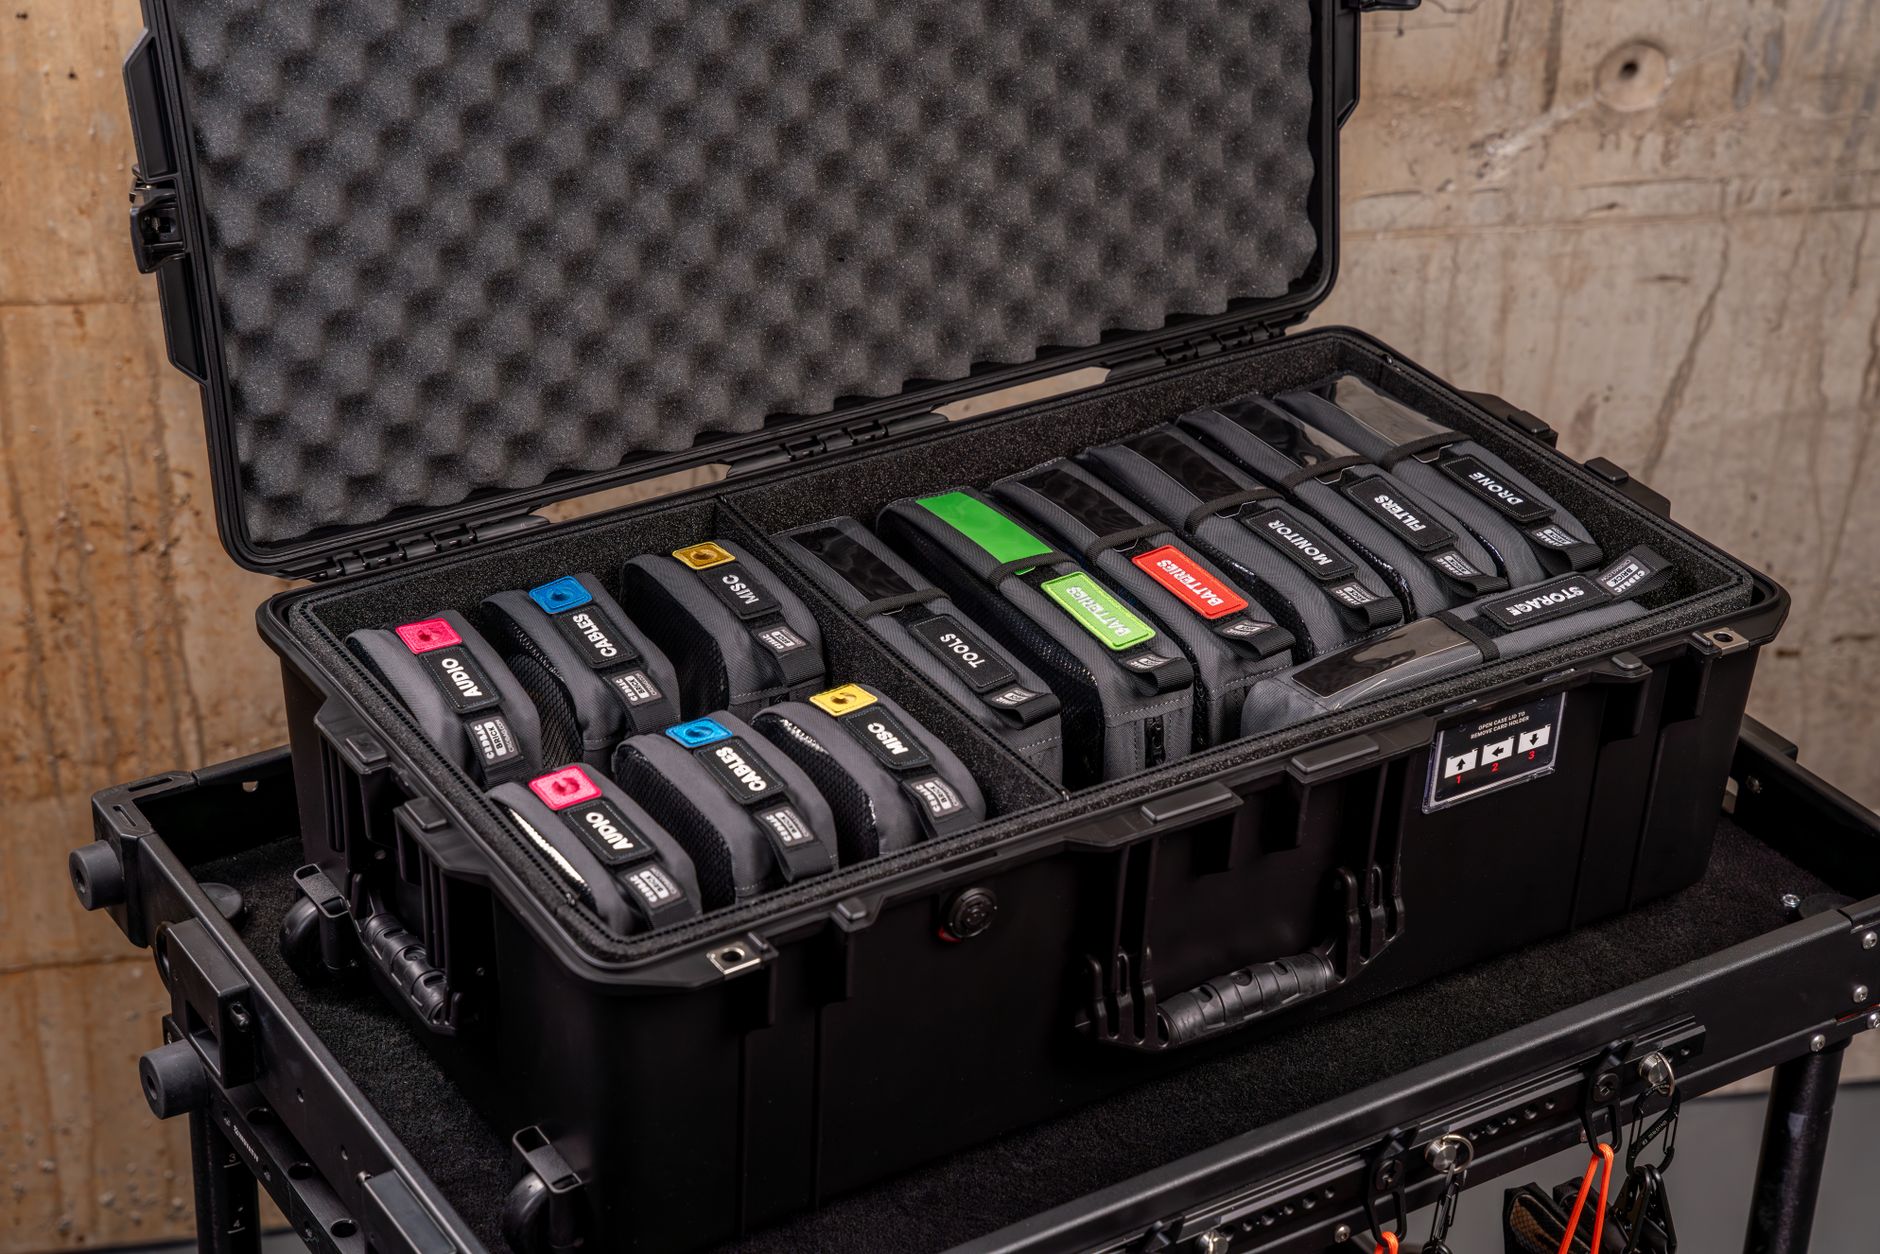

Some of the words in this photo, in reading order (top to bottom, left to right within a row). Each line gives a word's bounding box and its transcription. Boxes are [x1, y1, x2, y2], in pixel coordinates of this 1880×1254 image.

[1468, 471, 1524, 506] DRONE
[1374, 494, 1427, 532] FILTERS
[1268, 519, 1333, 566] MONITOR
[722, 574, 760, 605] MISC
[1156, 559, 1225, 607] BATTERIES
[1611, 567, 1634, 584] BRICK
[1065, 585, 1132, 637] BATTERIES
[1504, 585, 1585, 617] STORAGE
[572, 613, 618, 657] CABLES
[939, 633, 986, 669] TOOLS
[441, 657, 483, 697] AUDIO
[629, 678, 646, 695] BRICK
[488, 726, 503, 750] BRICK
[867, 722, 909, 755] MISC
[1470, 727, 1493, 740] REMOVE
[1493, 722, 1508, 732] CARD
[1508, 715, 1530, 727] HOLDER
[1478, 721, 1493, 731] OPEN
[1493, 716, 1508, 726] CASE
[1508, 713, 1518, 721] LID
[715, 746, 767, 791] CABLES
[1456, 774, 1462, 784] 1
[1491, 762, 1499, 772] 2
[1528, 751, 1536, 760] 3
[930, 785, 947, 803] BRICK
[585, 811, 634, 850] AUDIO
[228, 1153, 236, 1163] 3
[232, 1219, 241, 1228] 4
